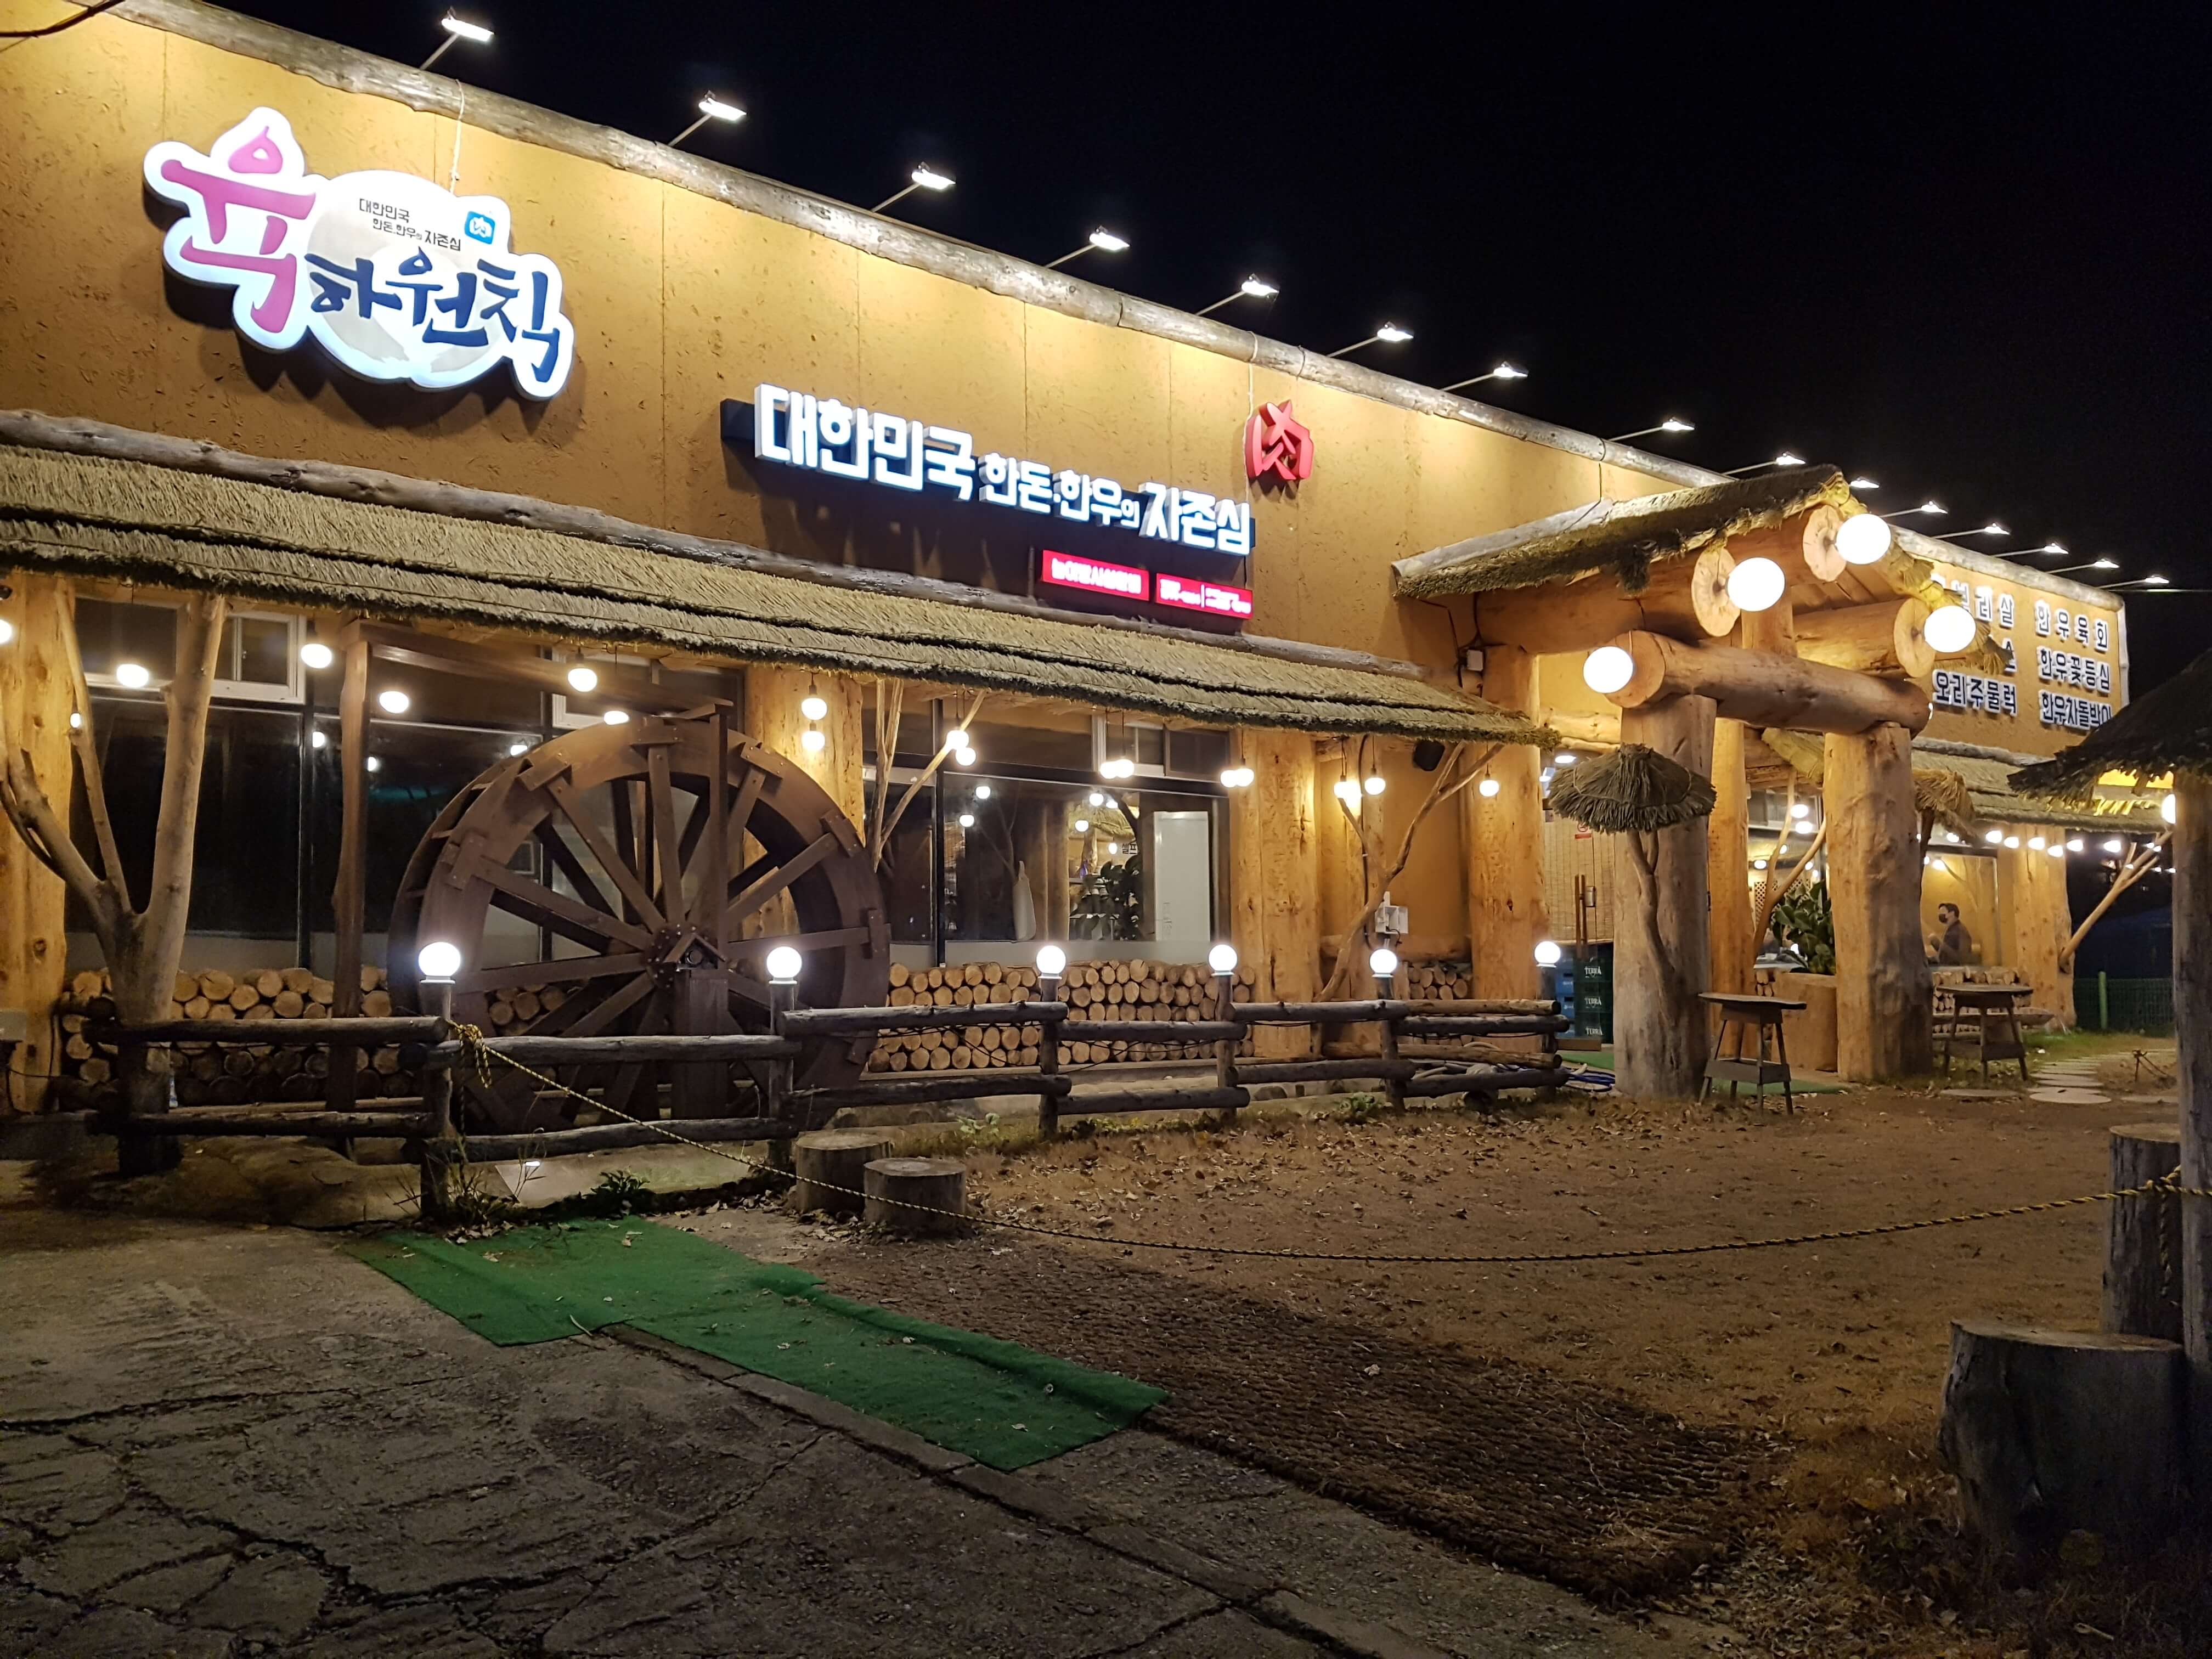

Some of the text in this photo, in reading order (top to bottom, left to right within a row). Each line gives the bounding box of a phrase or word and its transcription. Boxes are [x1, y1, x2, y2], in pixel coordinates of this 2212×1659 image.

[359, 198, 410, 223] 대한민국
[424, 229, 461, 251] 자존심
[754, 383, 976, 501] 대한민국
[1139, 482, 1250, 556] 자존심
[1933, 669, 2018, 716] 오리주물럭
[2037, 646, 2110, 693] 한우꽃등심
